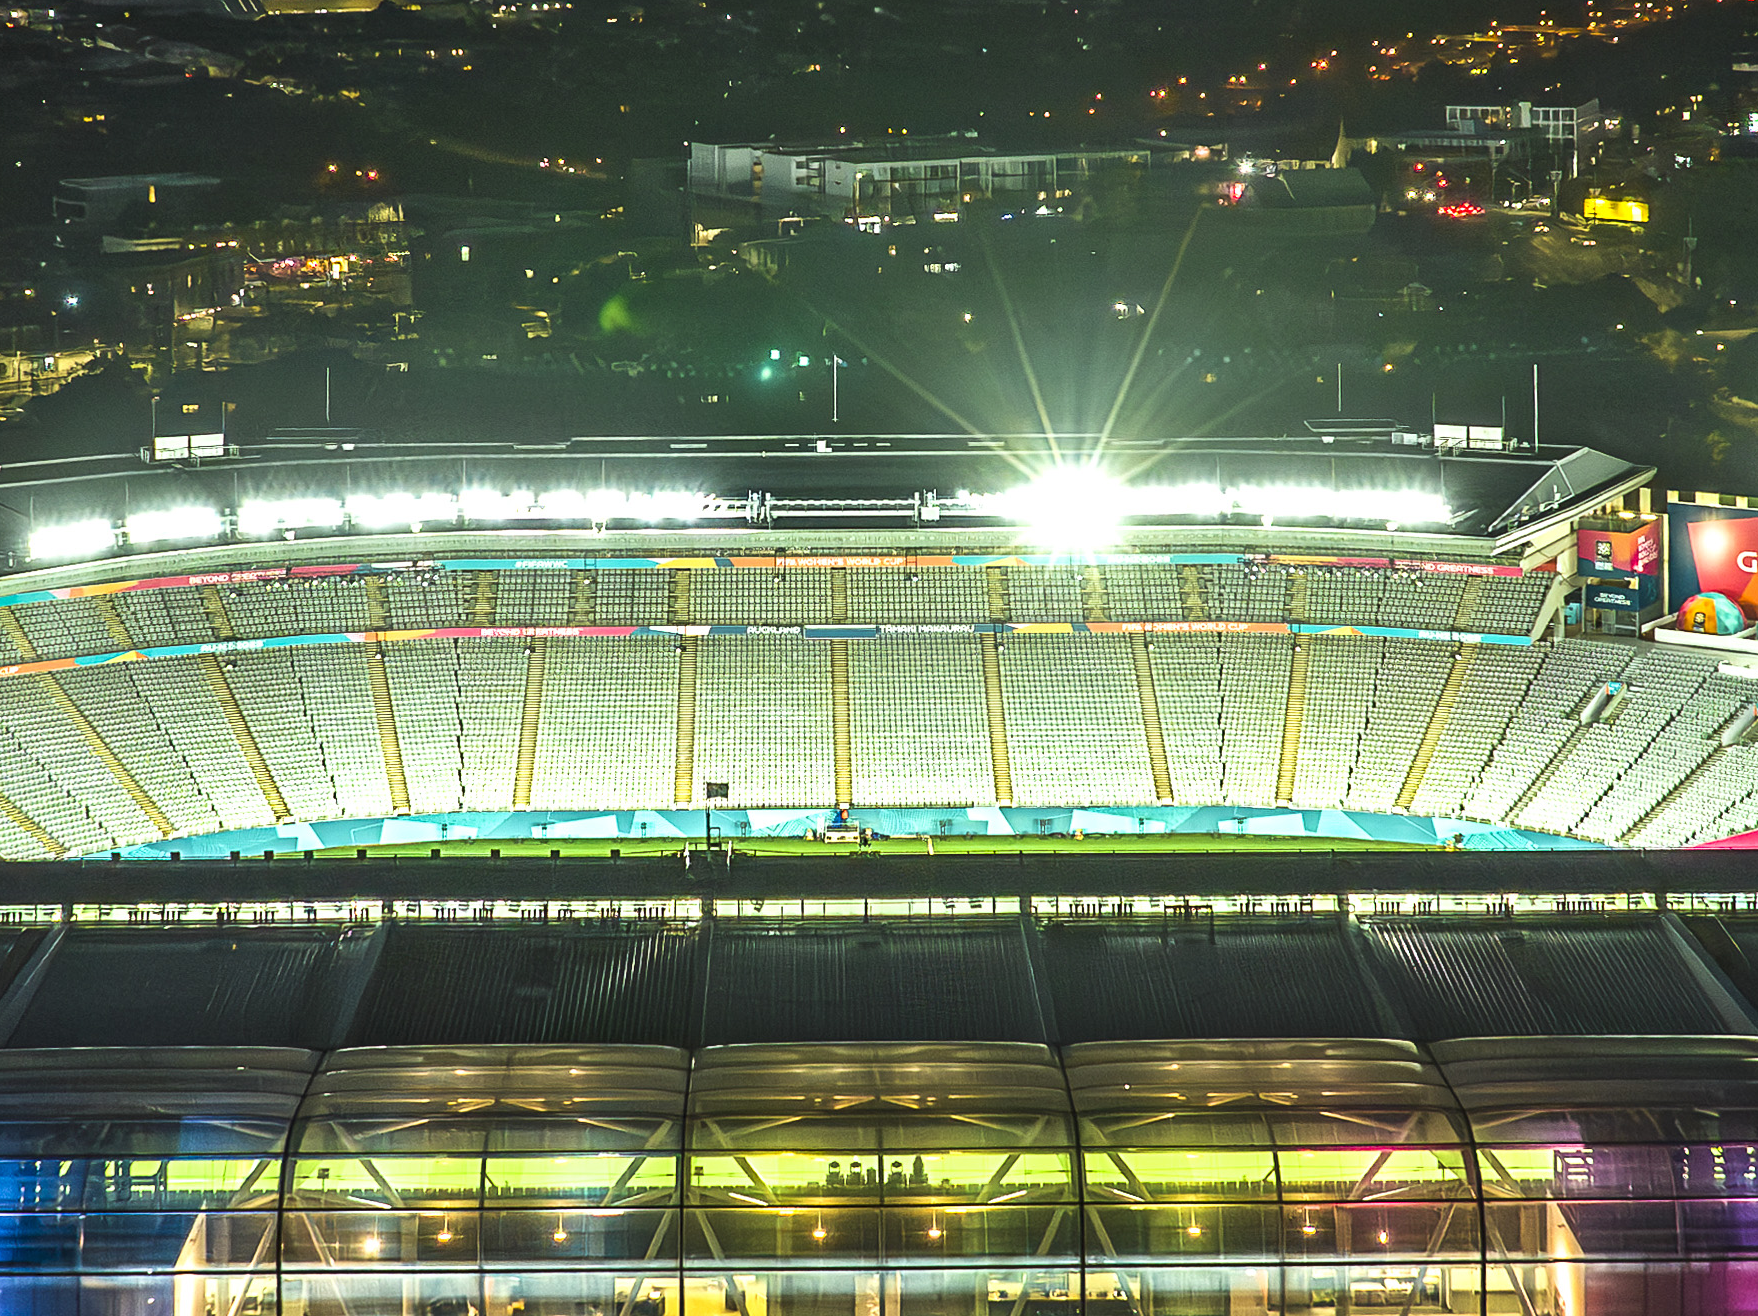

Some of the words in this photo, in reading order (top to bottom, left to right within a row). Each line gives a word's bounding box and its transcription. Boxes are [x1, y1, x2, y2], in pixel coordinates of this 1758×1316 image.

[846, 557, 881, 566] WORLD
[883, 557, 904, 566] CUP
[1436, 563, 1494, 575] GREATNESS
[189, 574, 229, 585] BEYOND
[746, 625, 801, 635] AUCKLAND
[1227, 623, 1248, 632] CUP
[0, 665, 20, 677] CUP
